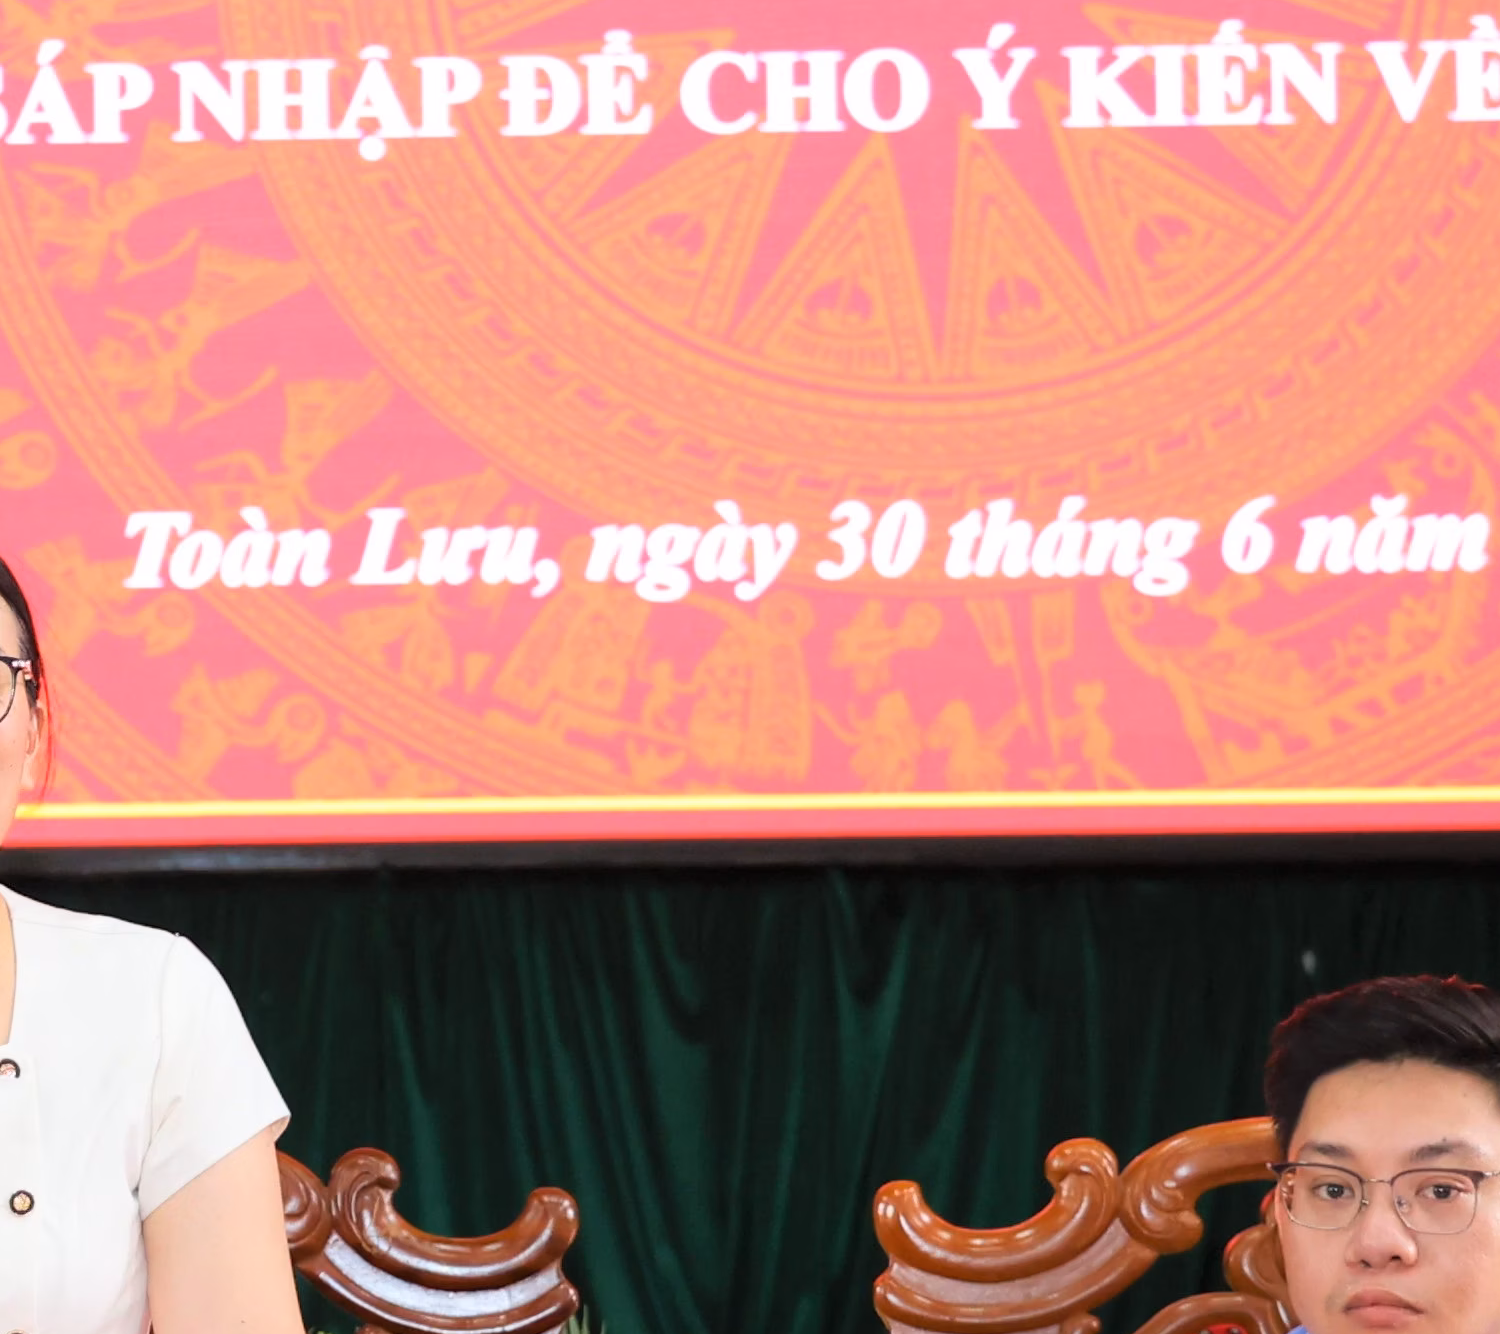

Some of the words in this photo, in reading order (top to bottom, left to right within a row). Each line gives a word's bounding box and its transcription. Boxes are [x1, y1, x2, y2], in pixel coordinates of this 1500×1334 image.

[172, 45, 482, 161] NHẬP
[500, 31, 652, 136] ĐỂ
[680, 49, 929, 134] CHO
[954, 24, 1034, 129] Ý
[1062, 20, 1342, 127] KIẾN
[124, 507, 330, 589] Toàn
[351, 508, 560, 597] Lưu,
[585, 500, 797, 602] ngày
[816, 499, 926, 580] 30
[945, 496, 1199, 596] tháng
[1222, 495, 1274, 573] 6
[1296, 495, 1490, 573] năm
